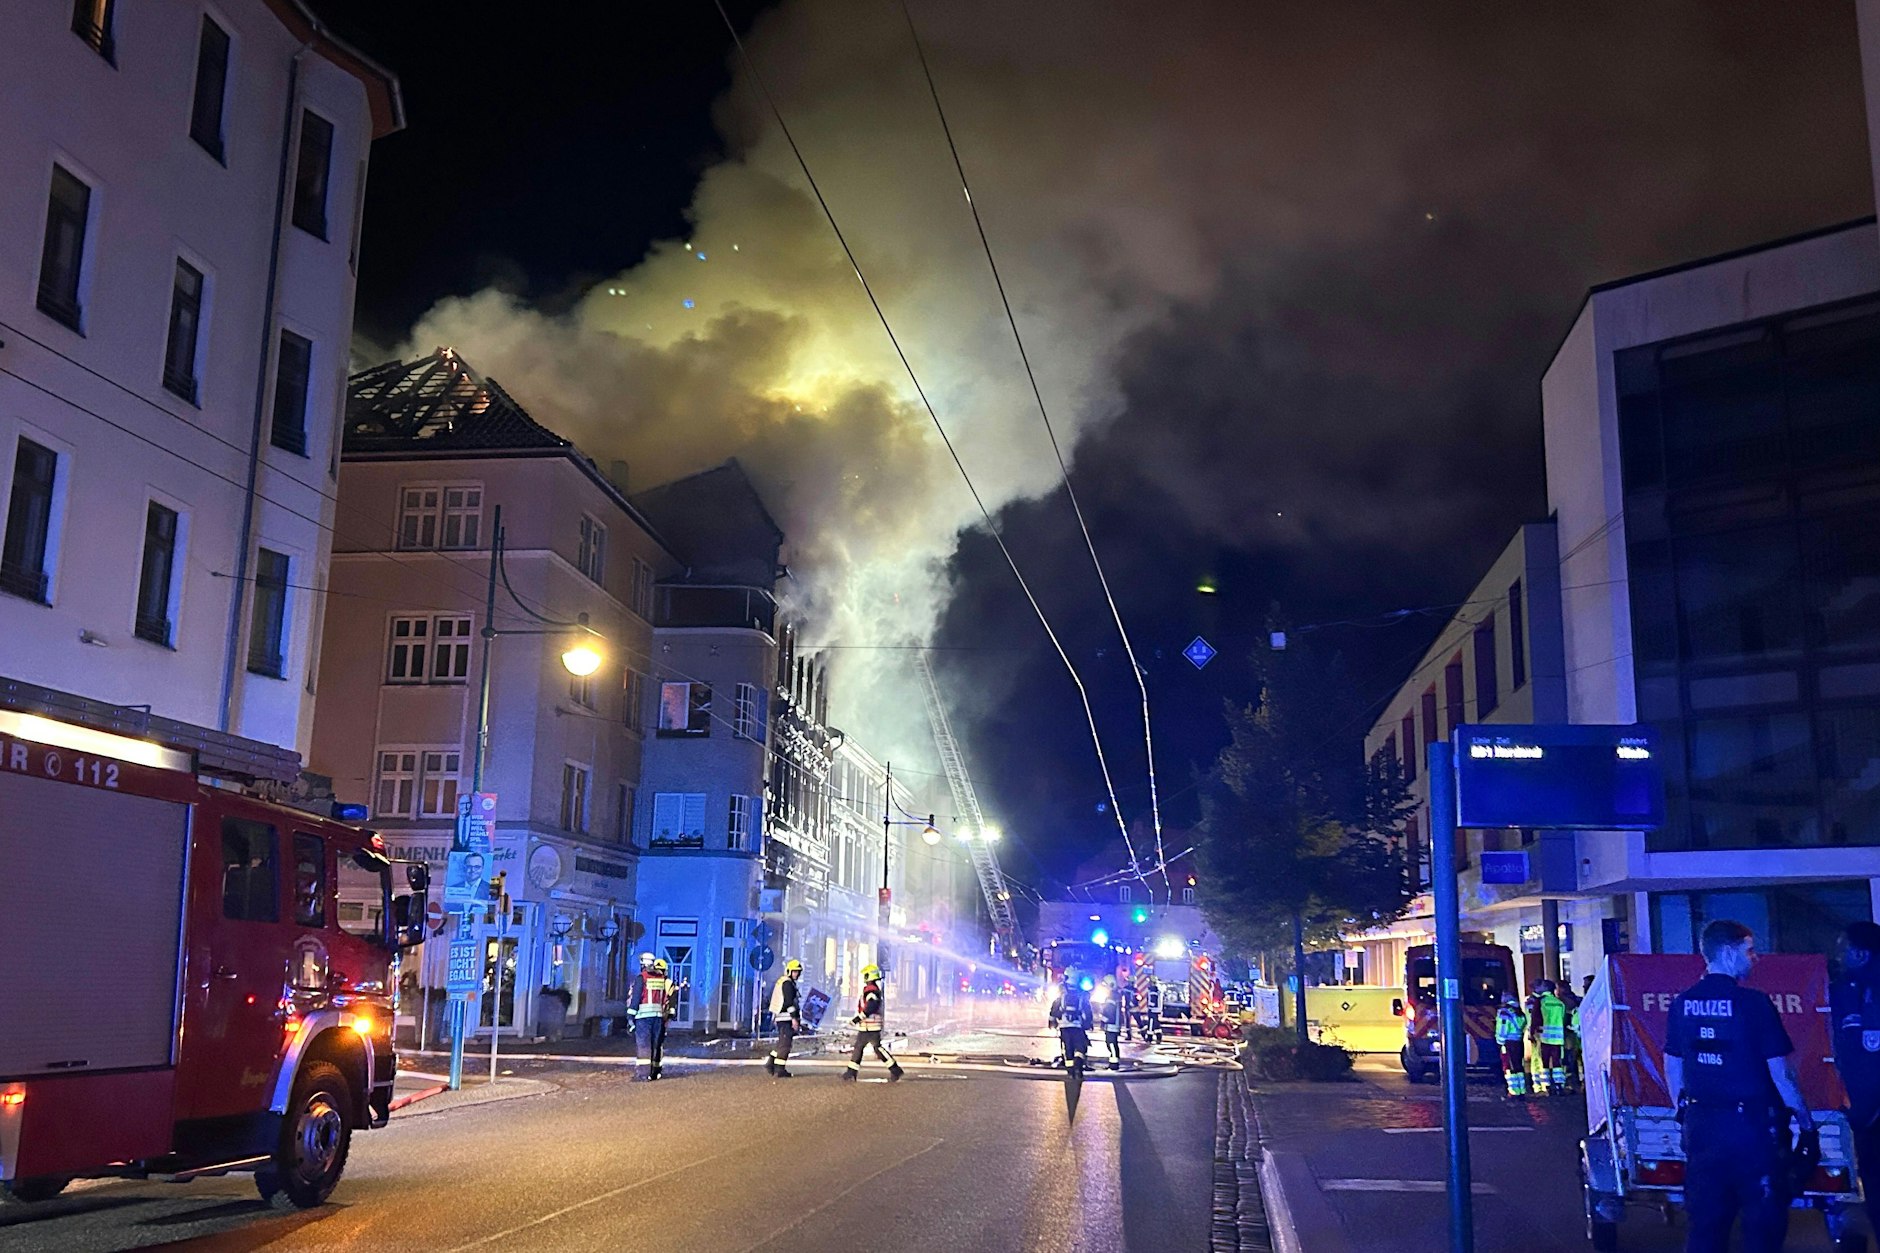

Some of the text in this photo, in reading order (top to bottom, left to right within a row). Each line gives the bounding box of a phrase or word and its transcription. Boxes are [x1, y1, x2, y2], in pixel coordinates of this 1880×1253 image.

[75, 758, 119, 788] 112
[450, 947, 476, 958] ES IST
[449, 970, 476, 981] EGAL!
[1684, 999, 1733, 1017] POLIZEI
[1700, 1027, 1715, 1038] BB
[1697, 1052, 1723, 1065] 41186
